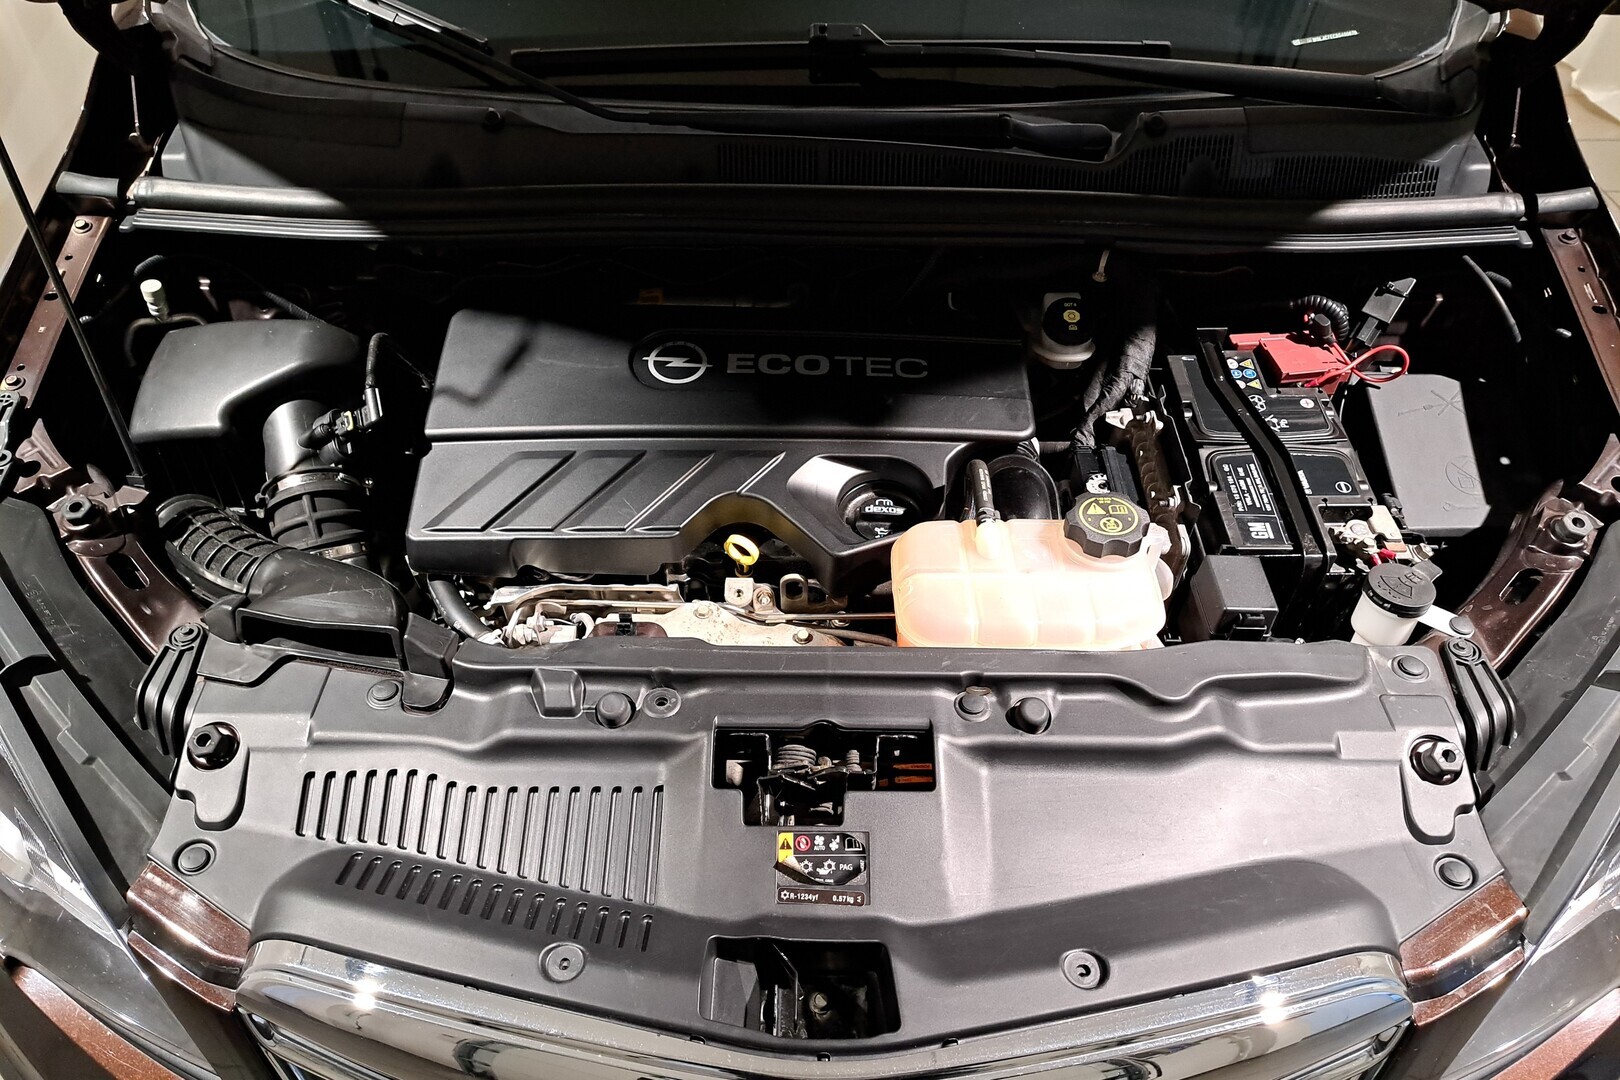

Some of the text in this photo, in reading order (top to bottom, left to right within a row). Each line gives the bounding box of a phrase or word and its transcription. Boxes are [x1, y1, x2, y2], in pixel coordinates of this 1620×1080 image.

[726, 353, 929, 379] ECOTEC
[865, 504, 907, 516] dexos
[1247, 522, 1270, 539] GM
[839, 863, 853, 871] PAG
[789, 892, 819, 902] R-1234yf
